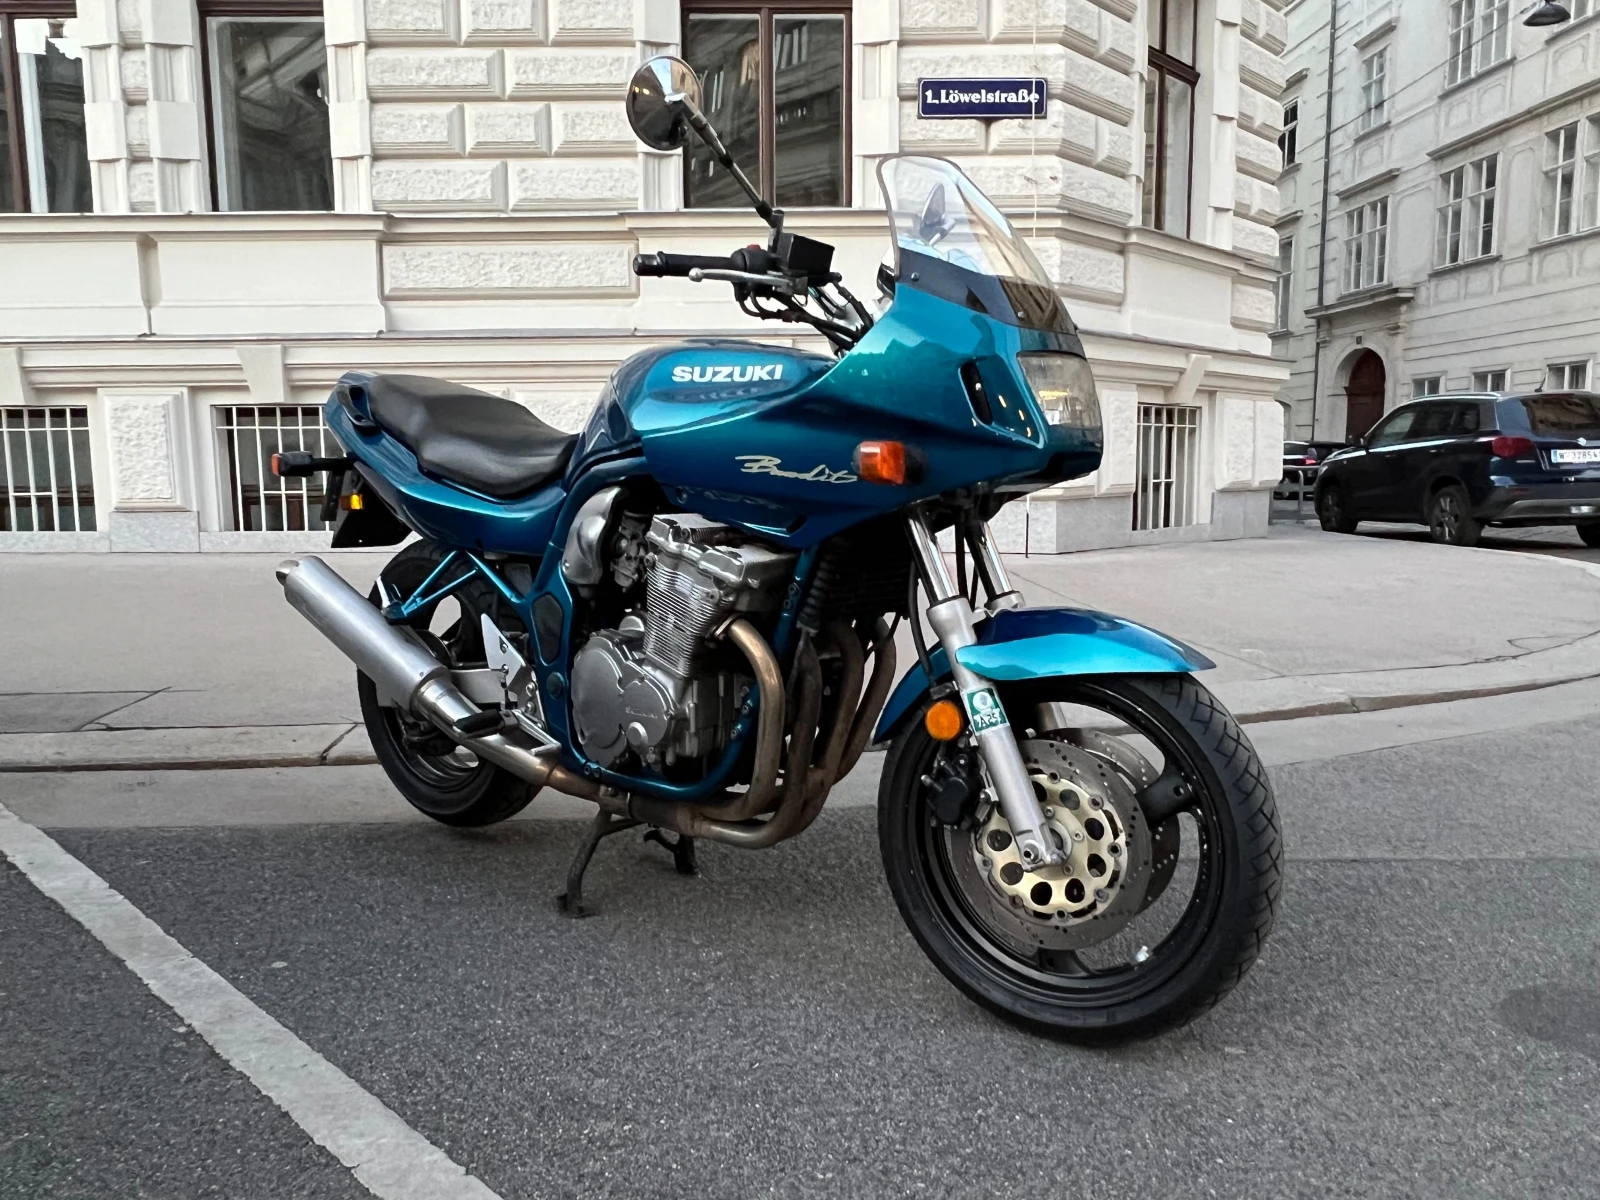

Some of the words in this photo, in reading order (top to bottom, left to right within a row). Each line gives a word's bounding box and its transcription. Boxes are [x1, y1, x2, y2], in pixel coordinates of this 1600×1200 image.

[940, 88, 1040, 104] Löwelstraße
[671, 364, 784, 383] SUZUKI
[1571, 450, 1600, 460] 37854
